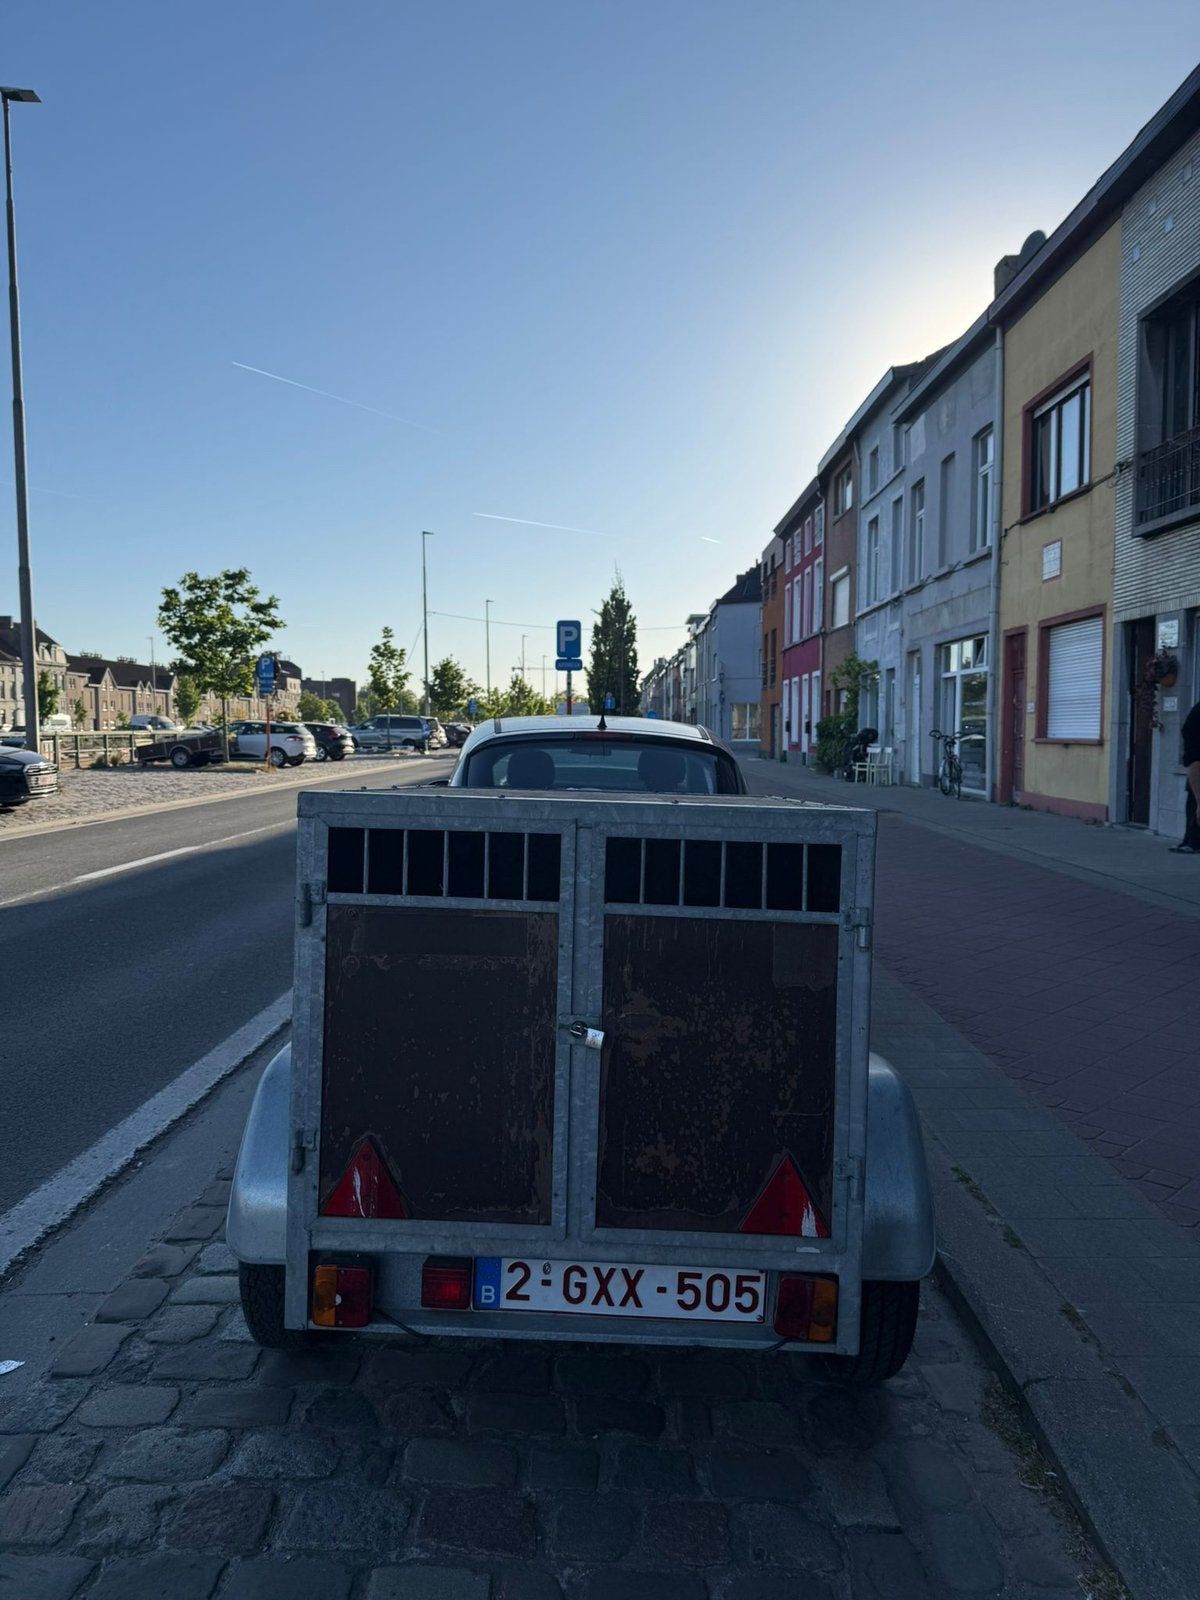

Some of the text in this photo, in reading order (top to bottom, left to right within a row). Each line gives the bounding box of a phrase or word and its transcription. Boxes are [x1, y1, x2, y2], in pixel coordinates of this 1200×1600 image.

[560, 627, 578, 652] P
[261, 658, 271, 670] P
[481, 1261, 761, 1314] B 2-GXX-505
